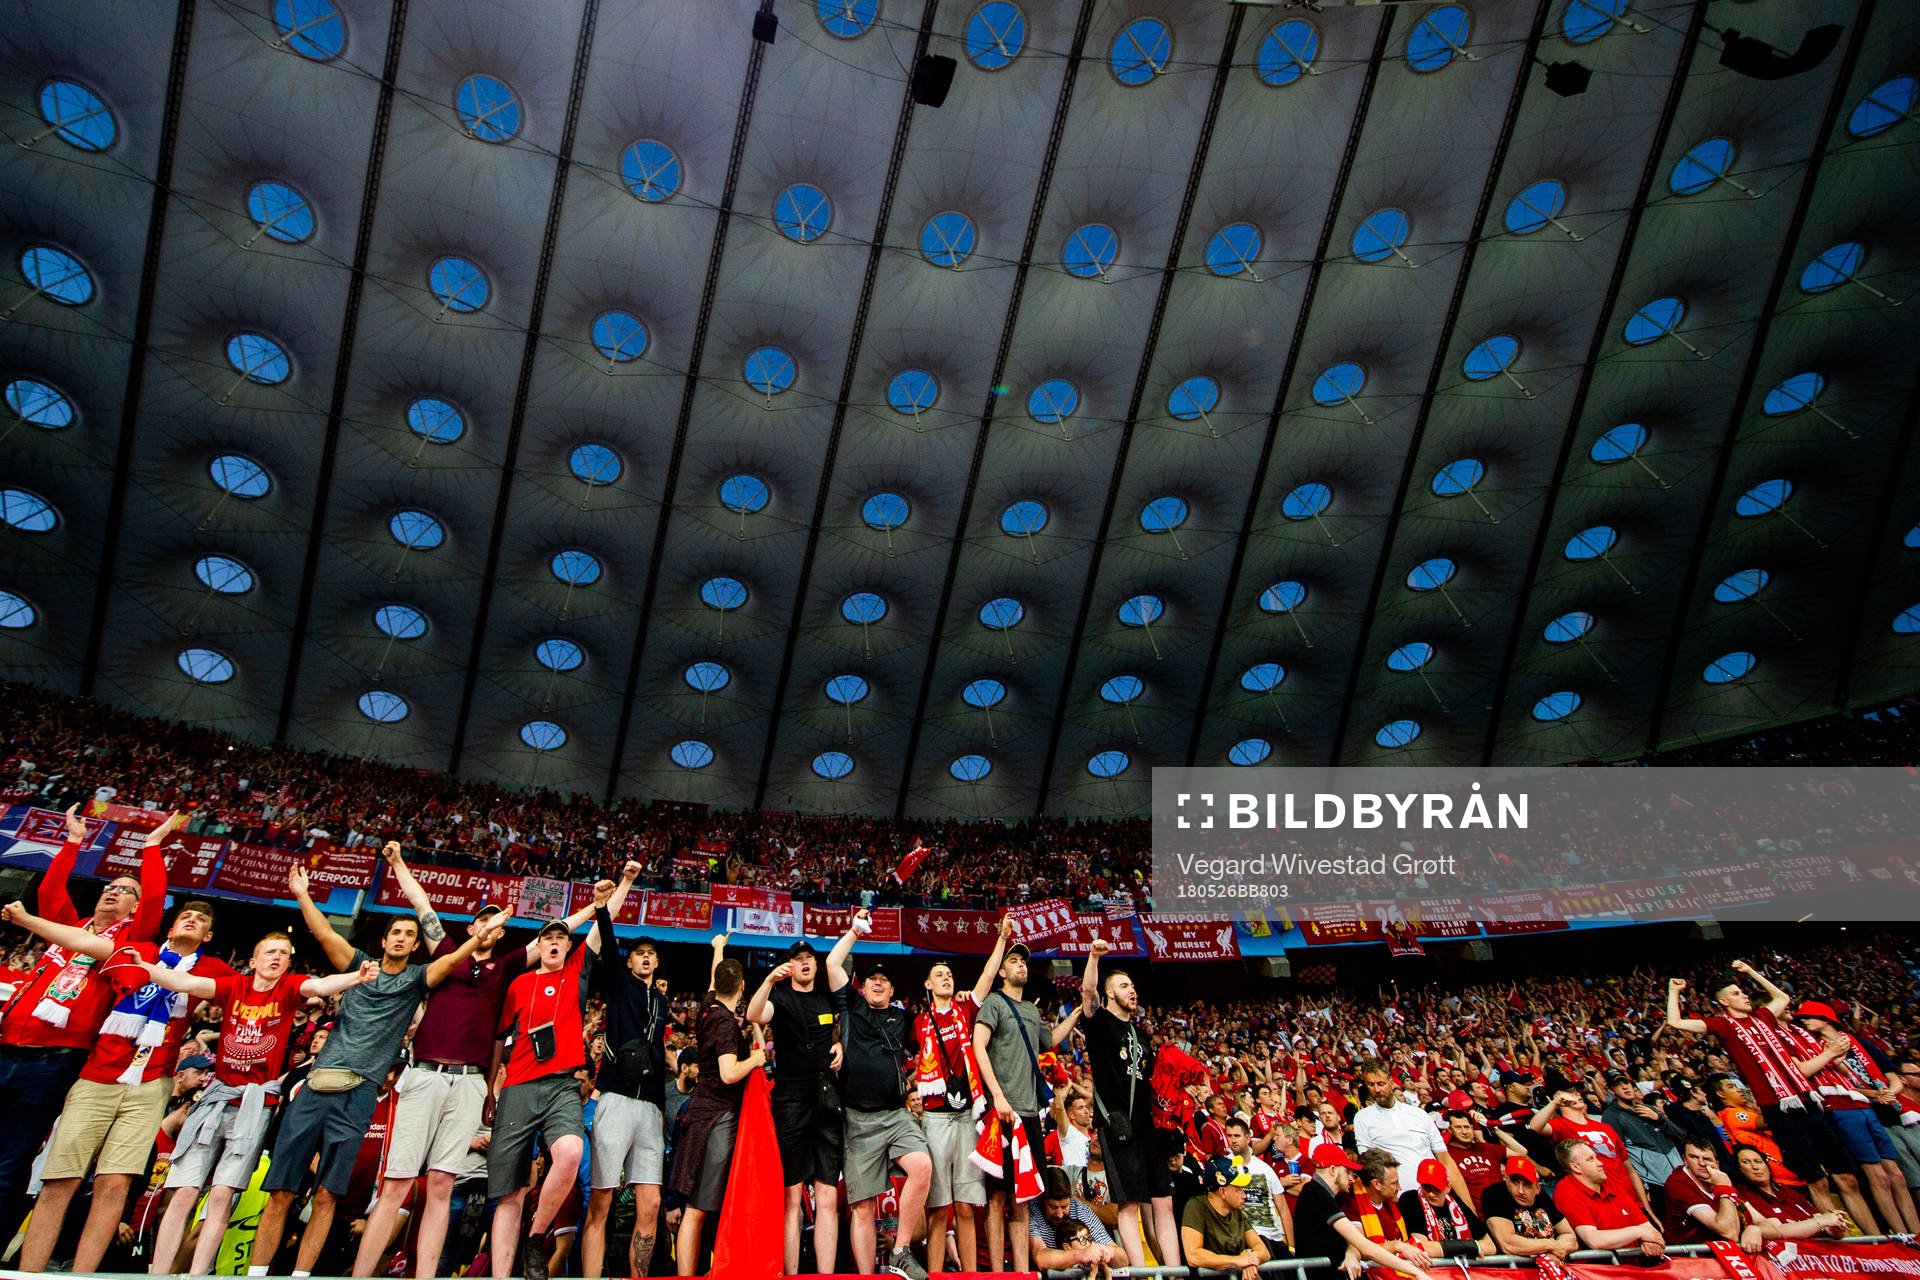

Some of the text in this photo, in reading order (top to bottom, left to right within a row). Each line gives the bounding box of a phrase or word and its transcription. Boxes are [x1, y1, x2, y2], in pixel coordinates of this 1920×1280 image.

[265, 852, 305, 865] CHAIRMA
[1781, 855, 1832, 869] CERTAIN
[1683, 862, 1760, 878] LIVERPOOL FC
[1779, 868, 1813, 881] STYLE
[387, 866, 487, 890] LERPOOL FC
[526, 878, 565, 892] SEAN COX
[1788, 880, 1817, 893] LIFE
[1626, 884, 1687, 900] SCOUSE
[1626, 896, 1701, 914] REPUBLIC
[1139, 913, 1230, 924] LIVERPOOL FC
[778, 923, 795, 933] ONE
[1183, 931, 1196, 939] MY
[1174, 941, 1211, 949] MERSEY
[1173, 951, 1219, 959] PARADISE
[236, 1025, 263, 1037] FINAL
[1822, 1254, 1842, 1273] TO
[1840, 1254, 1859, 1273] BE
